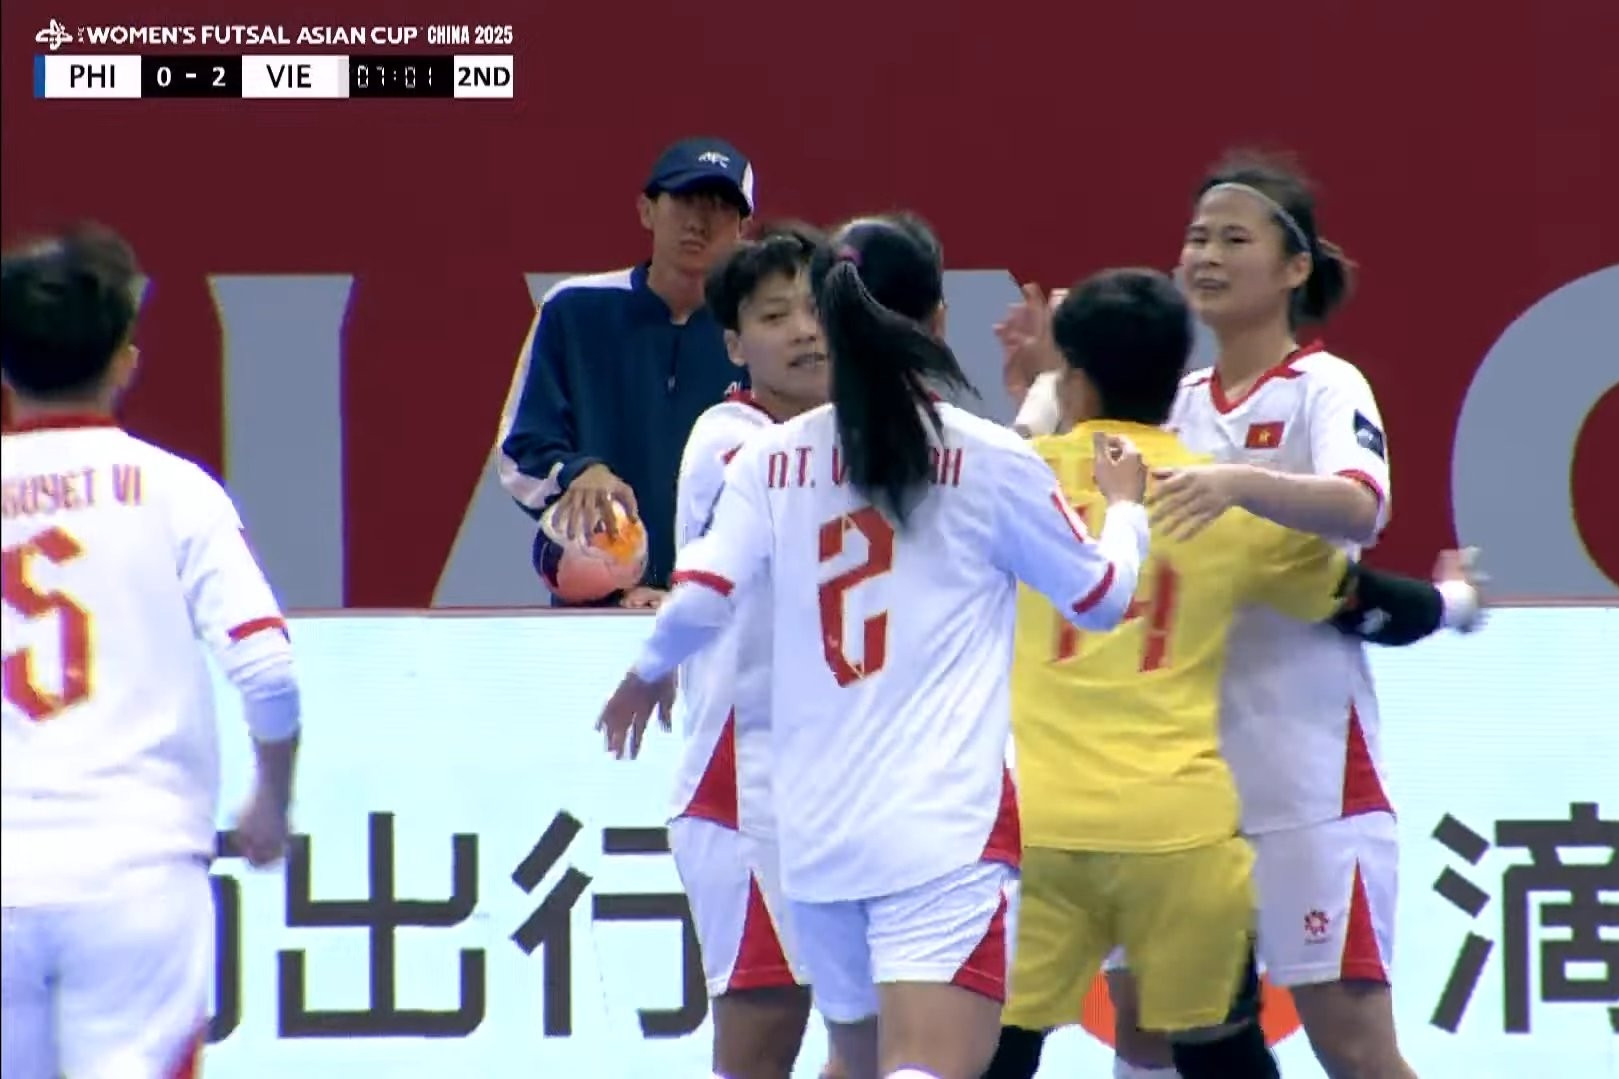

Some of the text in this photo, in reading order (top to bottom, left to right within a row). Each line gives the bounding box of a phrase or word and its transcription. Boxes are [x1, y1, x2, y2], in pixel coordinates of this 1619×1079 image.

[112, 463, 142, 506] VI
[2, 526, 95, 722] 5
[818, 504, 895, 688] 2
[205, 808, 708, 1043] 出行
[1429, 802, 1619, 1035] 滴
